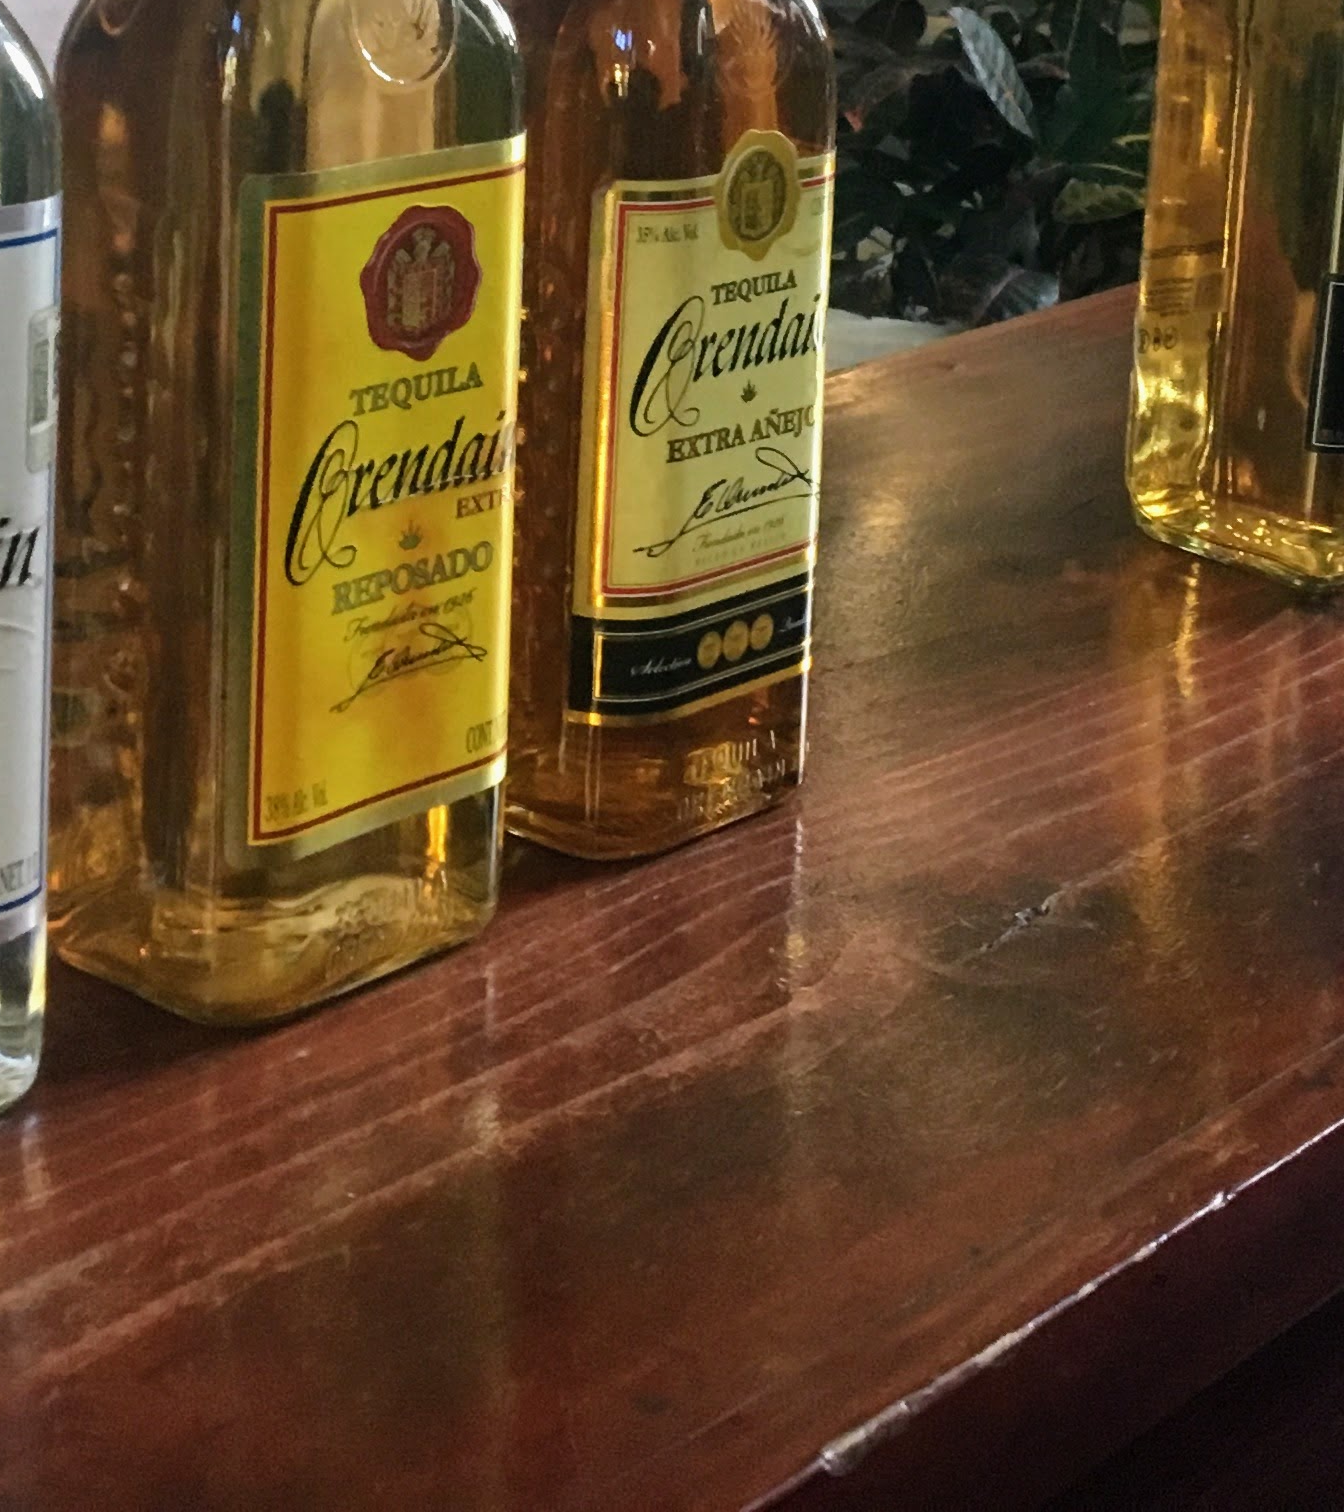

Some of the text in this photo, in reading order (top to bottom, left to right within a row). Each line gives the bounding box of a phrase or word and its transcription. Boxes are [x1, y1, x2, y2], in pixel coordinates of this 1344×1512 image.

[711, 269, 798, 306] TEQUILA
[348, 361, 484, 417] TEQUILA
[629, 292, 825, 438] Orendai
[665, 423, 749, 464] EXTRA
[331, 540, 494, 616] REPOSADO
